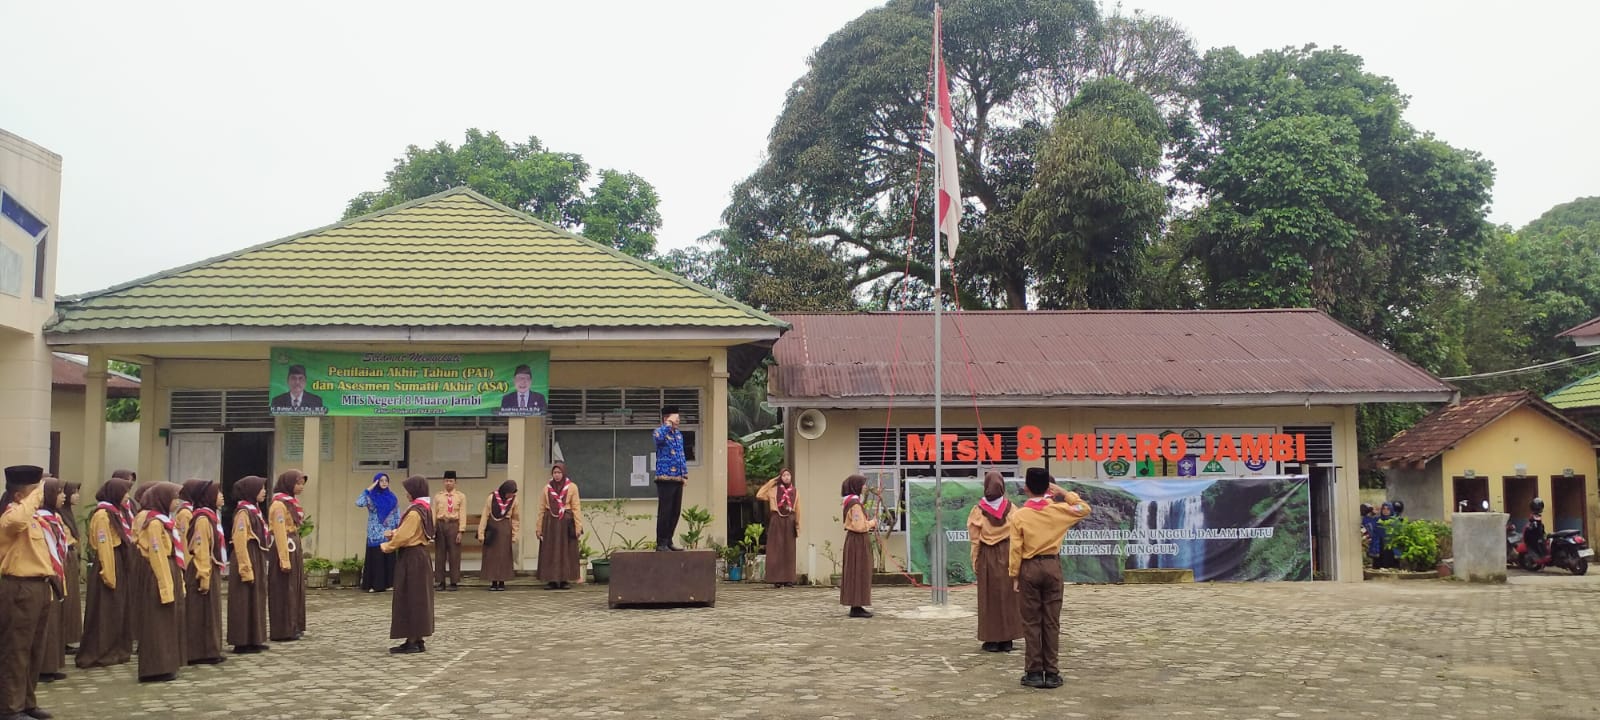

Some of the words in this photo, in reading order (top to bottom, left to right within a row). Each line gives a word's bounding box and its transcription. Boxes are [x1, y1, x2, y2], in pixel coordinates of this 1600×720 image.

[328, 366, 383, 377] Penilaian
[387, 367, 418, 378] Akhir
[422, 368, 458, 378] Tahun
[462, 367, 494, 379] (PAT)
[312, 380, 333, 390] dan
[338, 380, 390, 391] Asesmen
[394, 380, 439, 391] Sumatif
[442, 381, 474, 392] Akhir
[477, 381, 509, 392] (ASA)
[341, 394, 365, 405] MTs
[367, 394, 402, 407] Negeri
[405, 395, 412, 405] 8
[414, 395, 448, 405] Muaro
[451, 396, 482, 406] Jambi
[906, 433, 1003, 462] MTsN
[1016, 425, 1043, 462] 8
[1055, 433, 1187, 462] MUARO
[1199, 433, 1307, 462] JAMBI
[1065, 529, 1121, 541] KARIMAH
[1123, 529, 1146, 540] DAN
[1150, 528, 1195, 539] UNGGUL
[1197, 528, 1237, 539] DALAM
[1239, 527, 1274, 538] MUTU
[1113, 544, 1121, 555] A
[1125, 543, 1179, 555] (UNGGUL)
